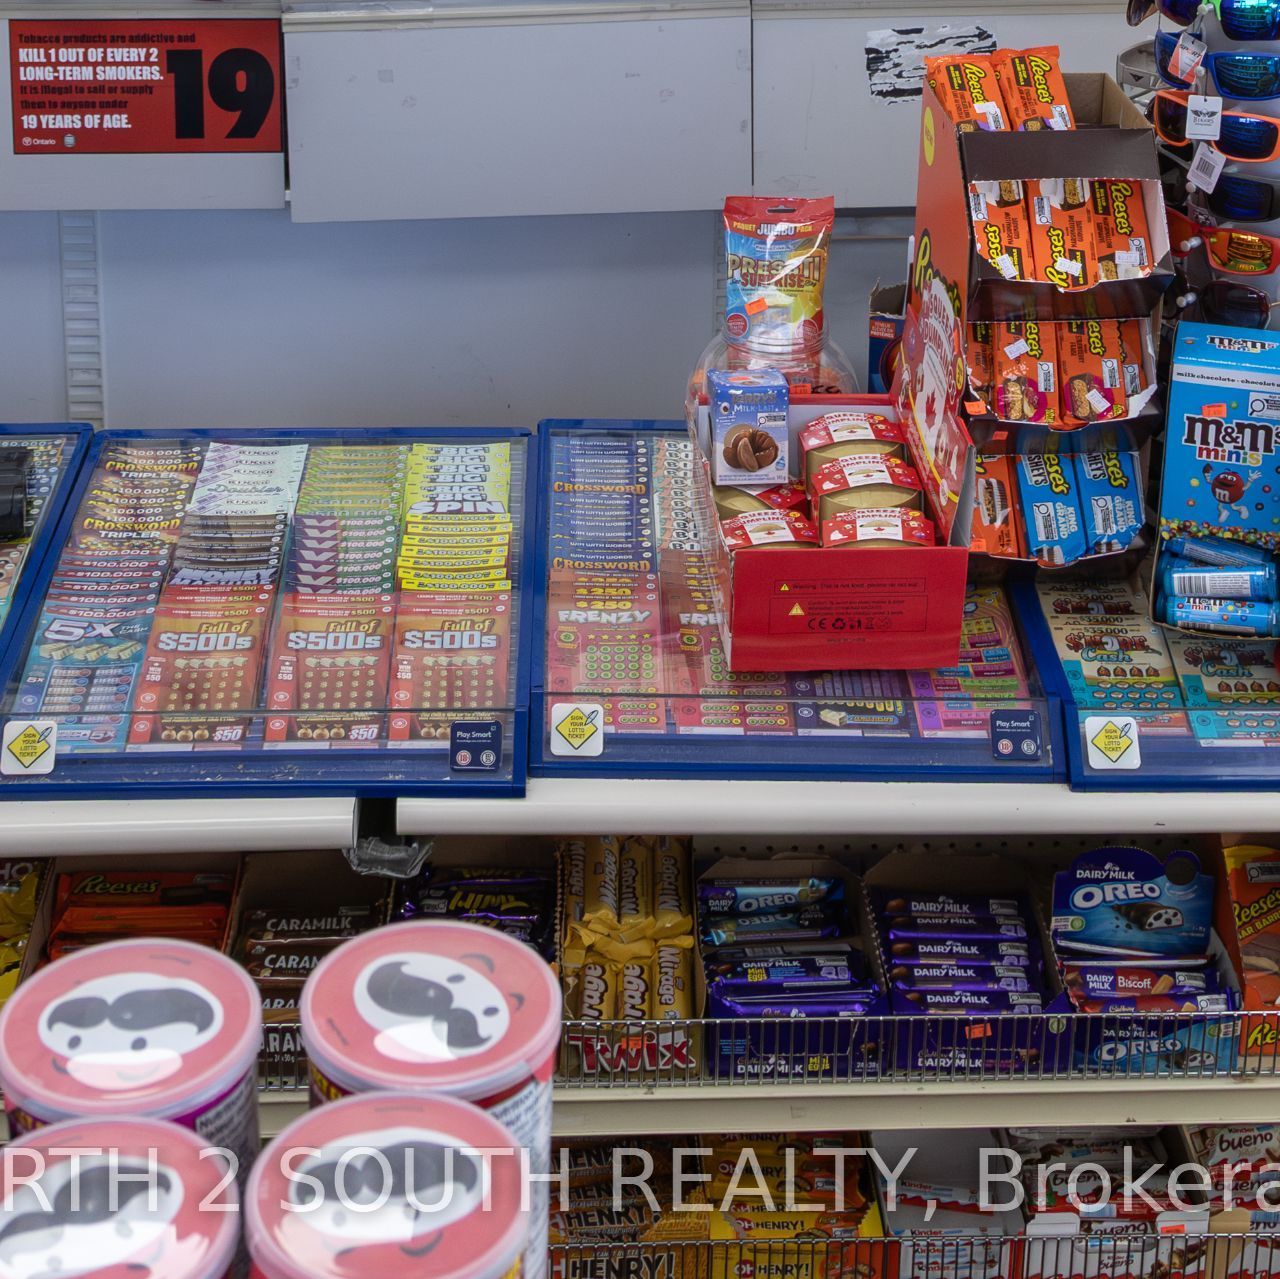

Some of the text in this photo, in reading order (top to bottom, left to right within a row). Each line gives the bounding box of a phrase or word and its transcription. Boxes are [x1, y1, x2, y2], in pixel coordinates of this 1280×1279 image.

[19, 34, 195, 44] Tobacco products are addictive and
[19, 48, 158, 62] KILL 1 OUT OF EVERY 2
[20, 67, 163, 80] LONG-TERM SMOKERS.
[166, 48, 275, 139] 19
[22, 100, 128, 110] them to anyone under
[22, 115, 131, 128] 19 YEARS OF AGE.
[733, 222, 813, 235] PAQUET JUMBO PACK
[84, 519, 179, 530] CROSSWORD
[99, 531, 160, 539] TRIPLER
[558, 610, 650, 624] FRENZY
[199, 620, 248, 633] Full of
[158, 632, 251, 650] $500s
[1071, 883, 1160, 908] OREO
[911, 902, 969, 914] DAIRY MILK
[1118, 977, 1151, 989] Biscoff
